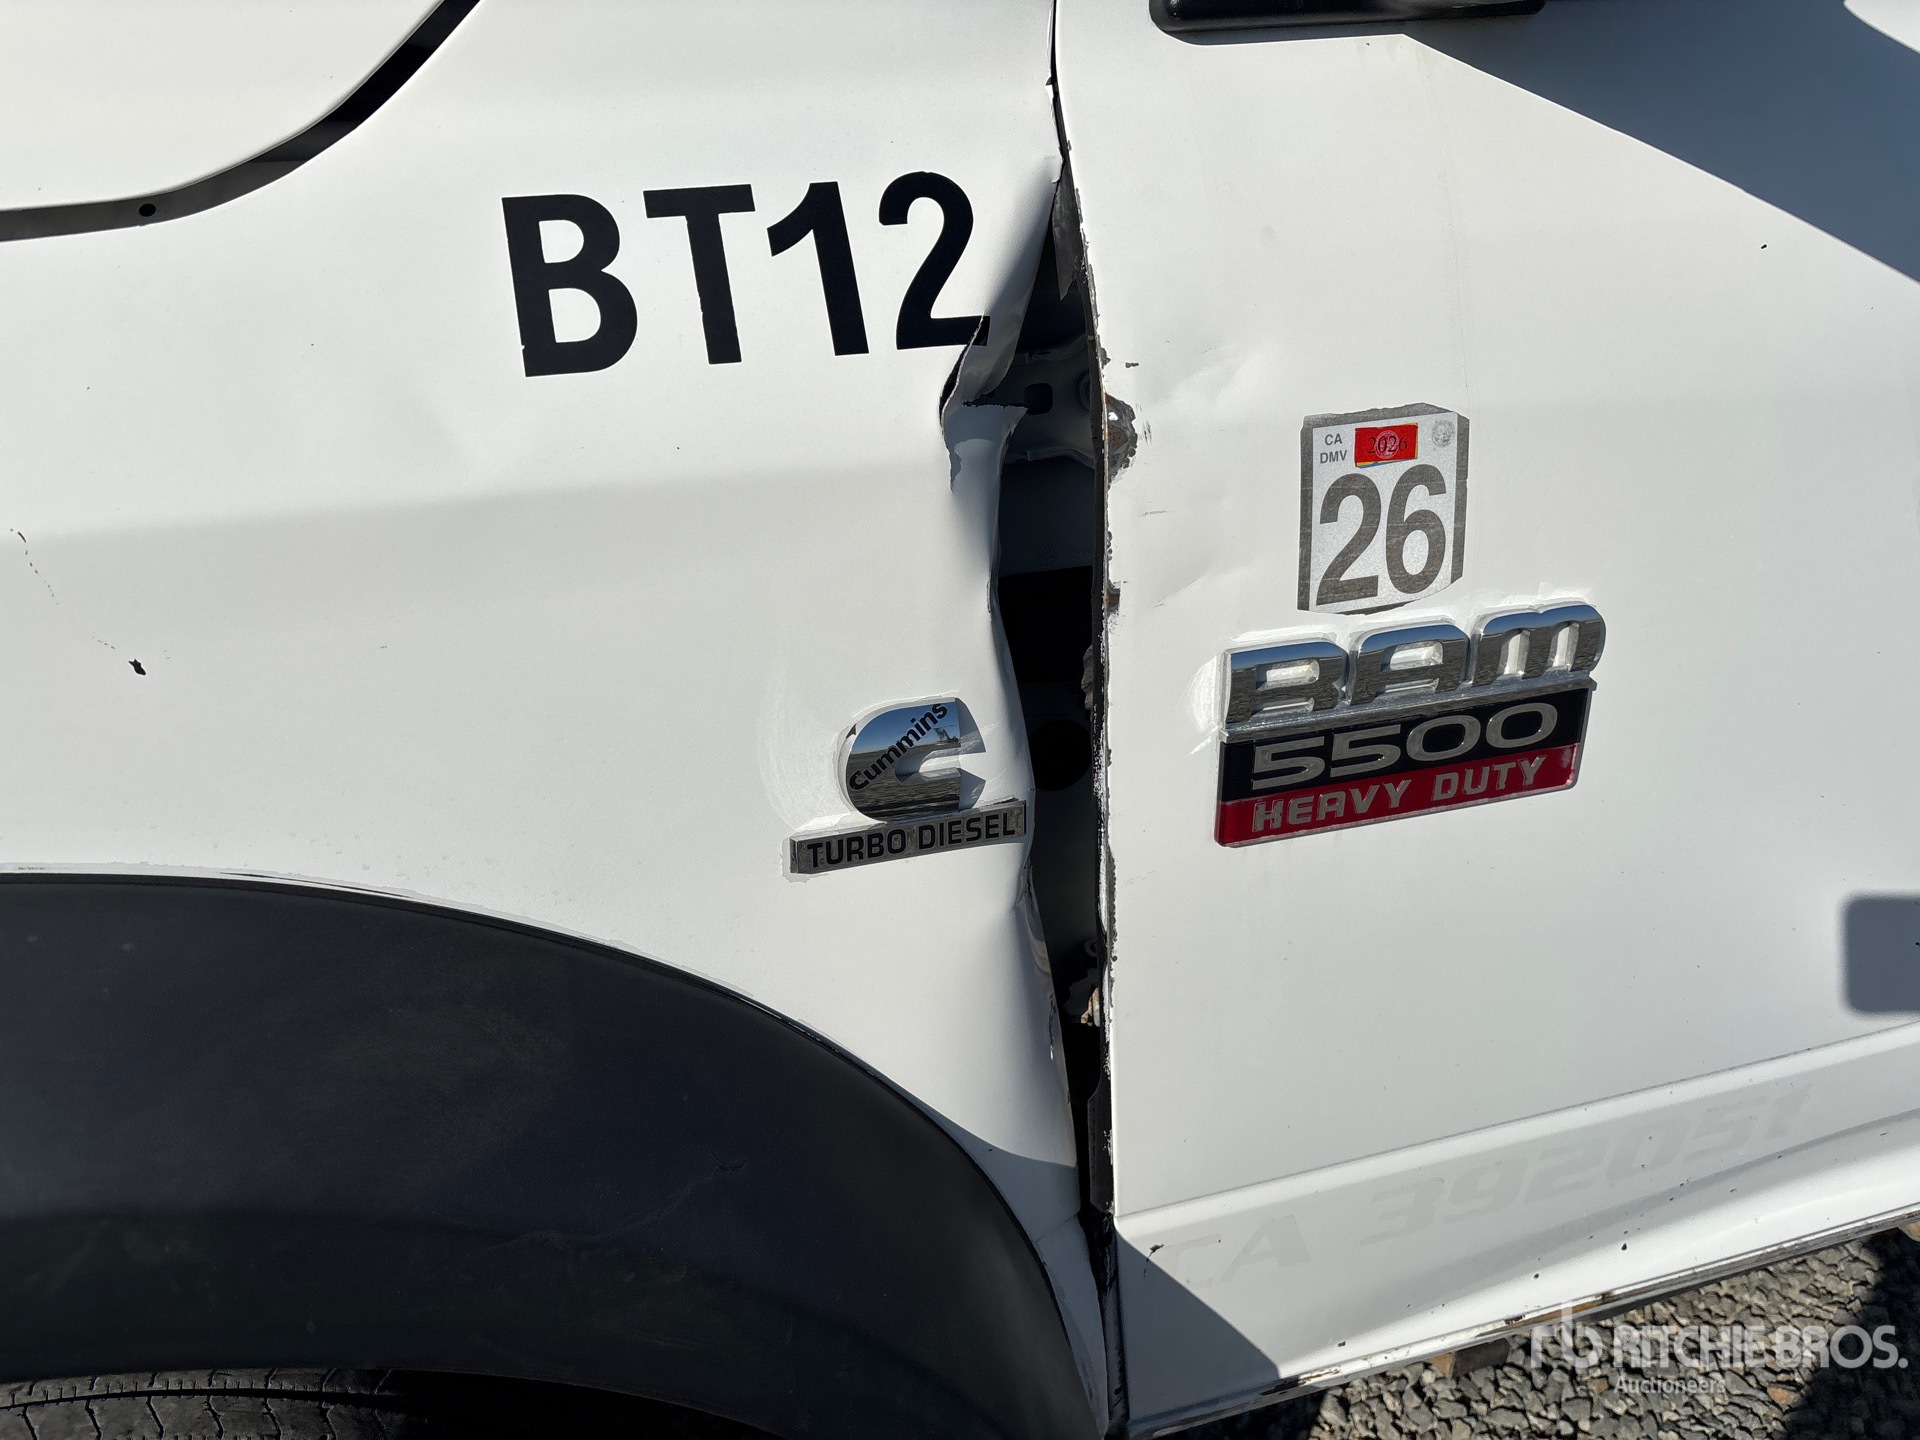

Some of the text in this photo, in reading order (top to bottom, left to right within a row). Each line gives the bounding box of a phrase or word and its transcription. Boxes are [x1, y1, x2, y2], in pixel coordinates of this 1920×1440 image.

[501, 171, 990, 377] BT12
[1319, 450, 1347, 464] DMV
[1325, 433, 1342, 446] CA
[1367, 434, 1408, 454] 2026
[1316, 463, 1447, 606] 26
[1222, 604, 1606, 725] RAM
[849, 702, 949, 790] Cummins
[1252, 702, 1558, 791] 5500
[1252, 755, 1547, 833] HEAVY DUTY
[807, 812, 1016, 868] TURBO DIESEL
